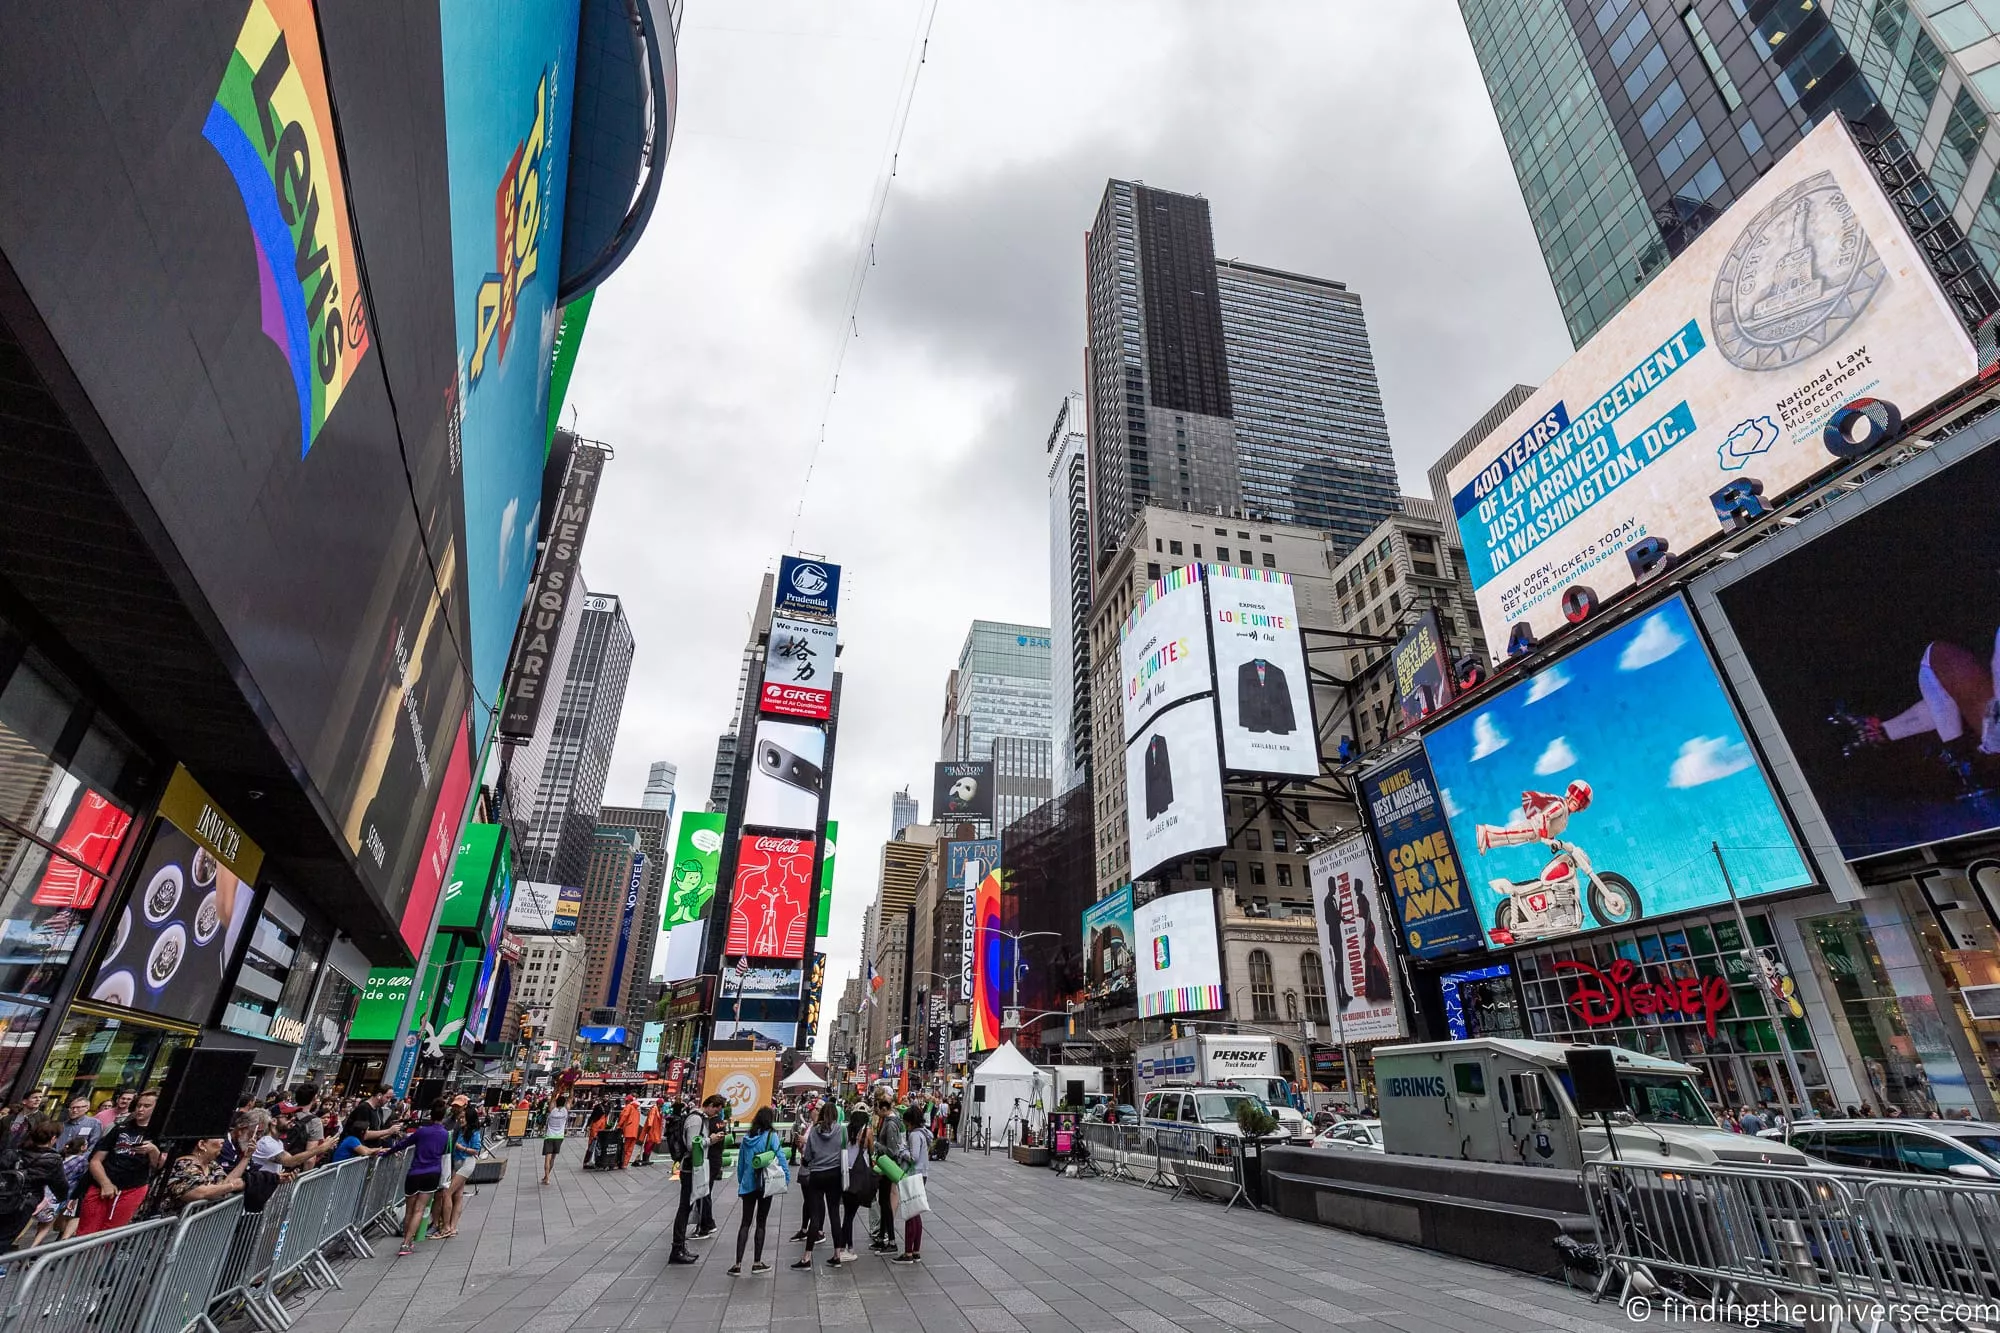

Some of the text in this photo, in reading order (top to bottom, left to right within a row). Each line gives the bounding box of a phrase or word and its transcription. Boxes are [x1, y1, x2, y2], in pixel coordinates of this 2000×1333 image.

[513, 66, 547, 298] TOY
[251, 29, 344, 386] Levi's
[1776, 345, 1867, 412] National Law
[1781, 356, 1873, 422] Enforcement
[1478, 330, 1690, 524] OF LAW ENFORCEMENT
[1785, 390, 1844, 432] Museum
[1473, 411, 1562, 499] 400 YEARS
[1486, 435, 1610, 548] JUST ARRIVED
[1489, 416, 1687, 575] IN WASHINGTON, DC.
[515, 468, 595, 699] TIMES SQUARE
[1500, 562, 1553, 603] NOW OPEN!
[1502, 517, 1637, 613] GET YOUR TICKETS TODAY
[1505, 523, 1648, 622] LawEnforcementMuseum.org
[786, 593, 828, 607] Prudential
[1219, 610, 1292, 630] LOVE UNITES
[1238, 602, 1266, 610] EXPRESS
[776, 622, 791, 630] We
[812, 628, 834, 637] Gree
[1396, 626, 1428, 667] ABOUT AS
[1128, 637, 1190, 701] LOVE UNITES
[1397, 639, 1430, 677] GUILTY AS
[1399, 642, 1437, 688] PLEASURES
[510, 713, 529, 721] NYC
[783, 689, 826, 704] GREE
[1372, 796, 1394, 819] BEST
[1393, 778, 1431, 810] MUSICAL
[1378, 768, 1413, 797] WINNER!
[1166, 815, 1179, 829] NOW
[1377, 818, 1385, 827] ALL
[1385, 812, 1401, 825] ACROSS
[1400, 805, 1414, 820] NORTH
[1414, 796, 1434, 815] AMERICA
[195, 804, 241, 863] INVICTA
[953, 845, 998, 858] MY FAIR
[1319, 854, 1333, 866] HAVE
[1339, 842, 1359, 856] REALLY
[1389, 830, 1450, 873] COME
[625, 860, 645, 912] NOVOTEL
[1313, 865, 1329, 877] GOOD
[1329, 860, 1343, 871] TIME
[1336, 871, 1357, 925] PRETTY
[1404, 879, 1461, 923] AWAY
[962, 882, 979, 998] COVERGIRL
[1346, 934, 1366, 998] WOMAN
[1553, 959, 1731, 1039] Disney
[1212, 1050, 1268, 1061] PENSKE
[1390, 1076, 1446, 1097] BRINKS
[1539, 1134, 1548, 1147] B
